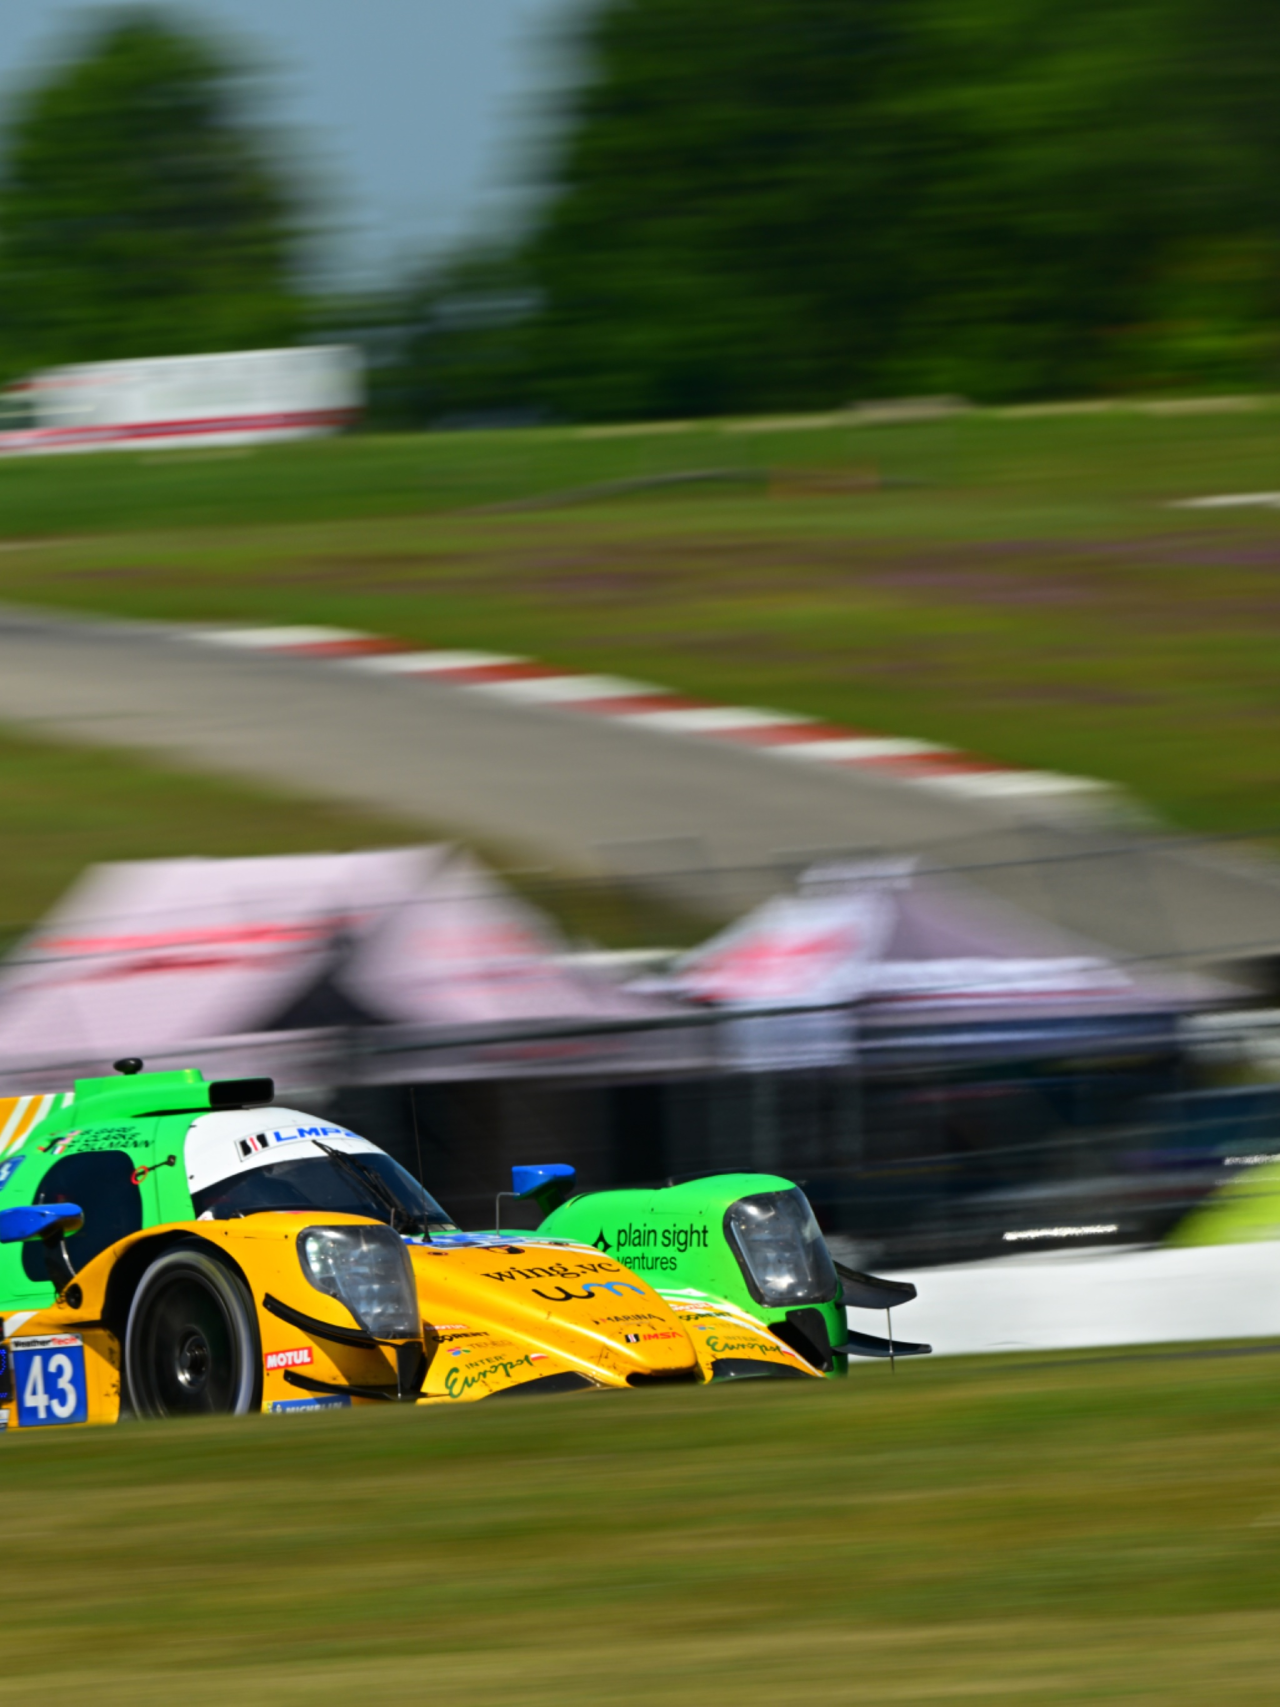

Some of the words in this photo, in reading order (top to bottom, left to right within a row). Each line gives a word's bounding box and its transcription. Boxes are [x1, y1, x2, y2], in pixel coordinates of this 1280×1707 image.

[616, 1222, 657, 1252] plain
[661, 1223, 709, 1252] sight
[480, 1262, 620, 1282] wing.vc
[643, 1331, 684, 1341] IMSA
[266, 1349, 311, 1369] MOTUL
[23, 1353, 78, 1419] 43
